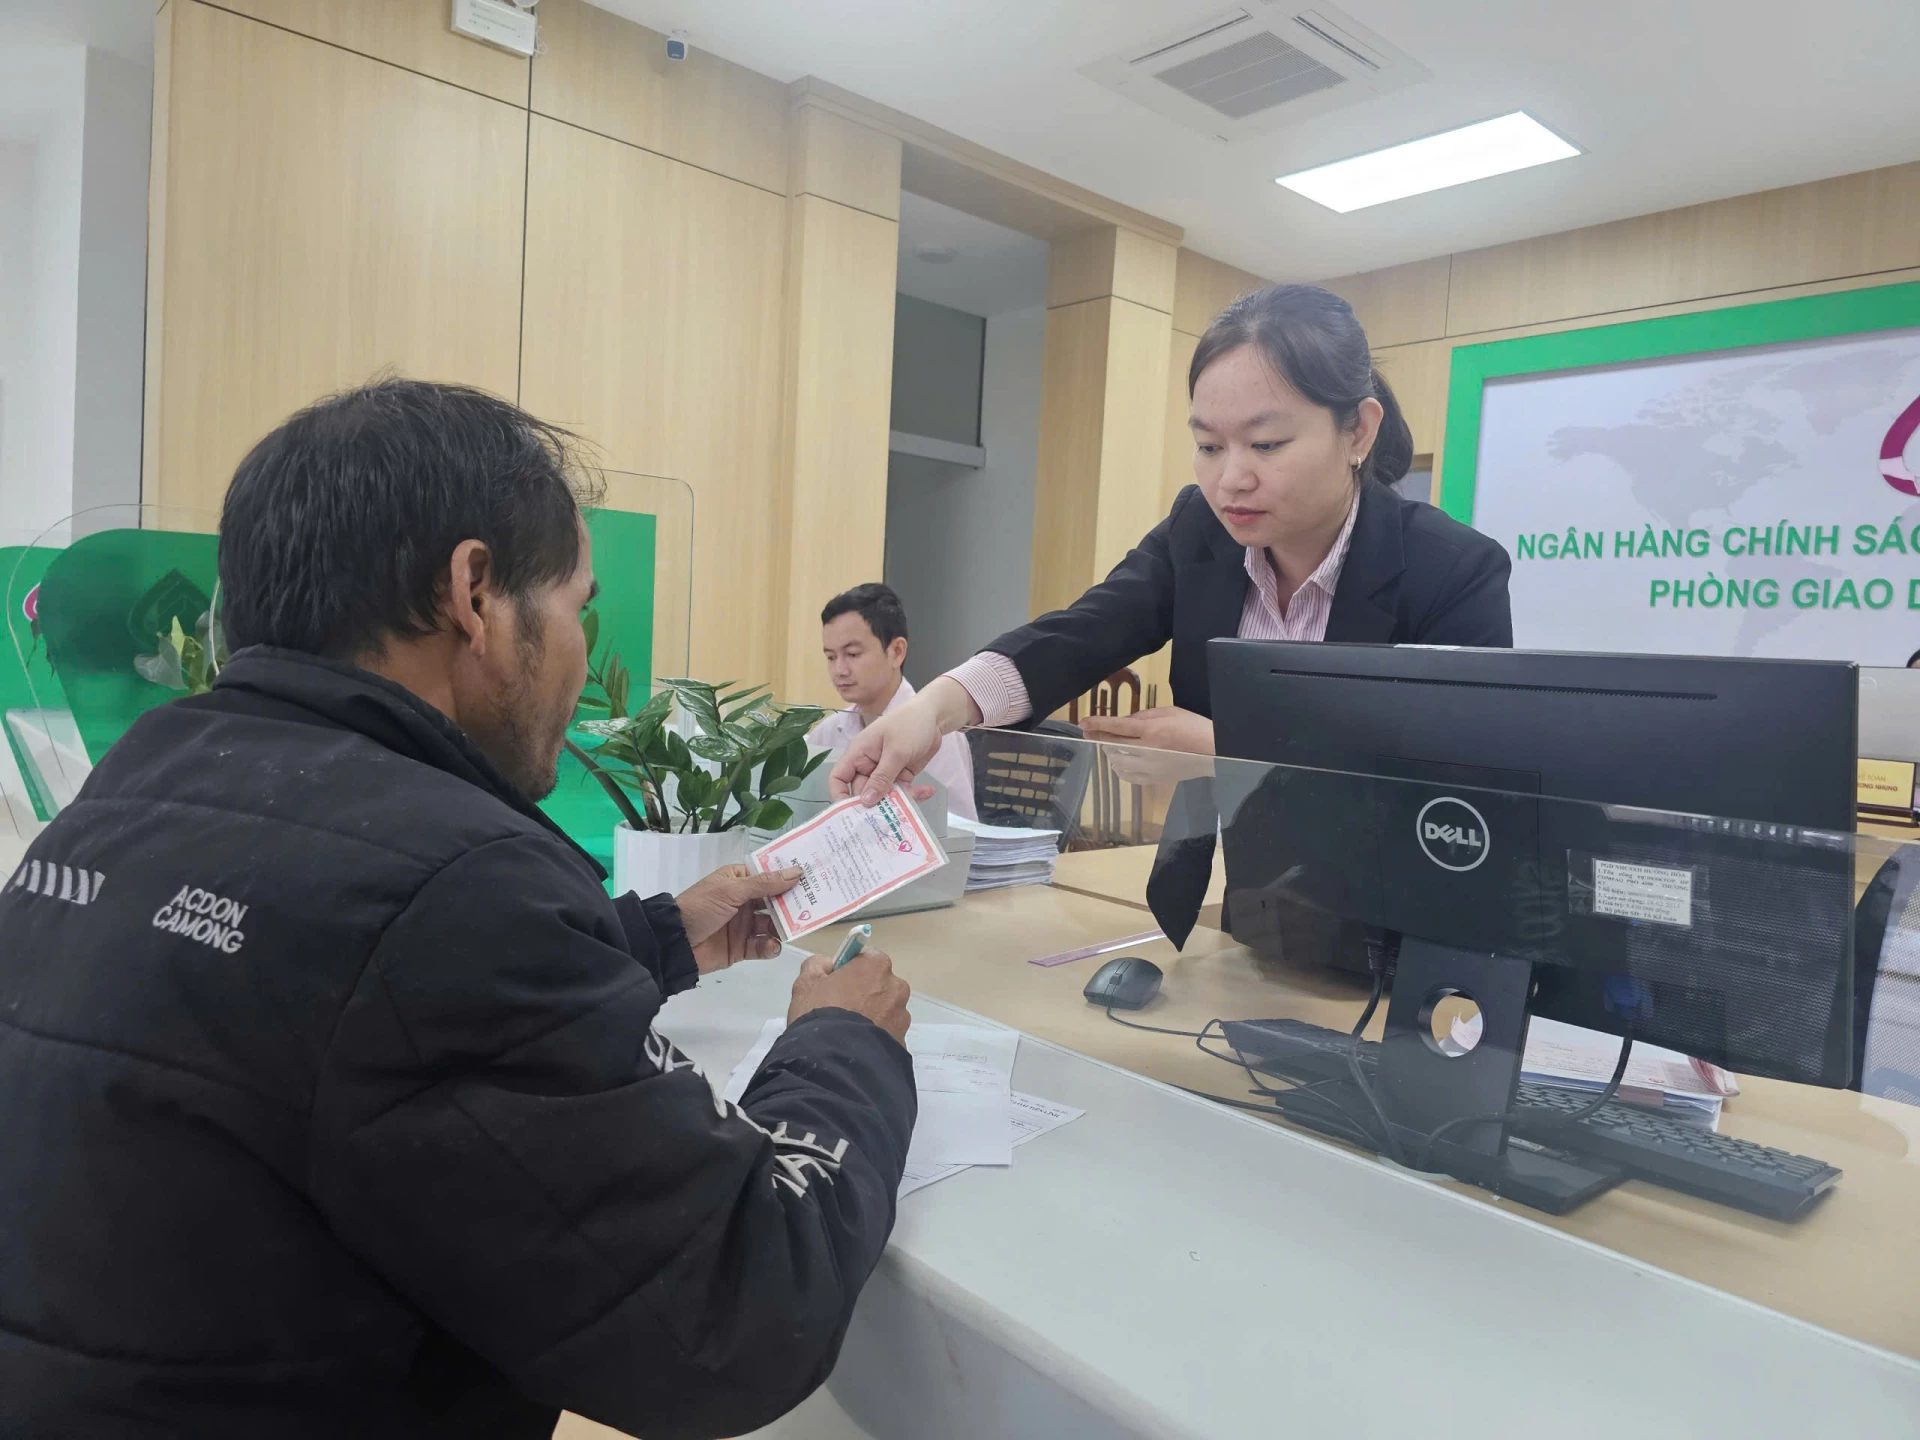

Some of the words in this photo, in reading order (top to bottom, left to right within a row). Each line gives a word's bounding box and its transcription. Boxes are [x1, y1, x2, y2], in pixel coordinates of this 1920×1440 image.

[1517, 527, 1603, 559] NGÂN
[1614, 524, 1710, 557] HÀNG
[1723, 519, 1839, 556] CHÍNH
[1649, 572, 1779, 608] PHÒNG
[1792, 578, 1893, 609] GIAO
[1425, 822, 1481, 847] DELL
[798, 877, 811, 892] TIẾT
[804, 892, 818, 905] THẺ
[170, 885, 248, 928] ACDON
[153, 905, 244, 953] CAMONG
